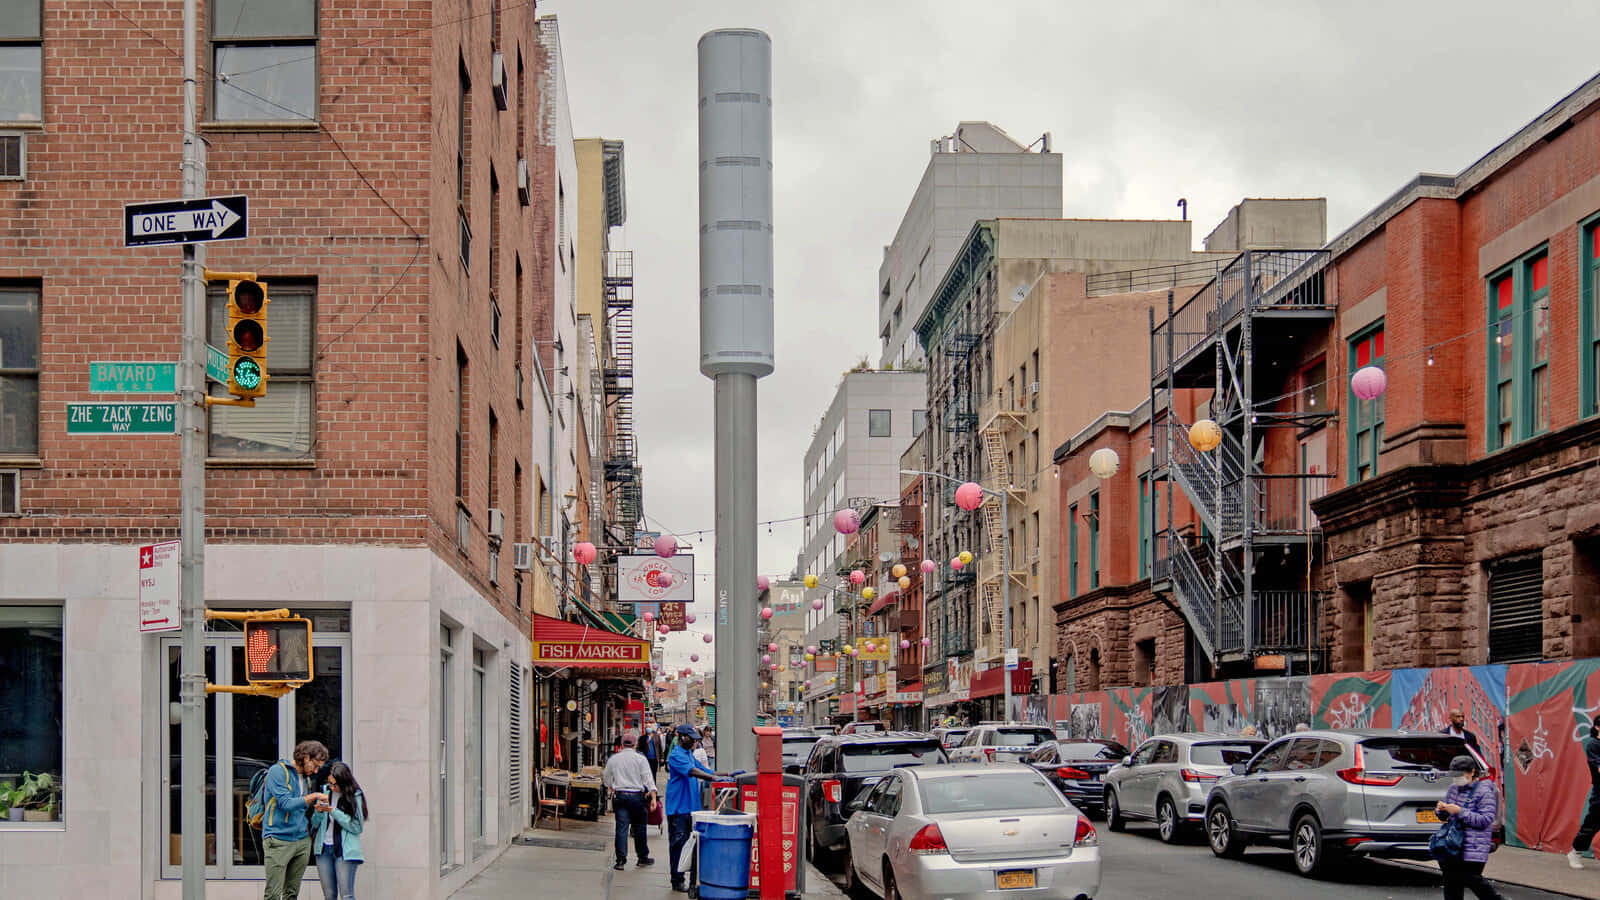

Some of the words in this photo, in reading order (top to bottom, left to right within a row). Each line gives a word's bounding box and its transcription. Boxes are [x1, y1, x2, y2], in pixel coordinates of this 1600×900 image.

[142, 214, 177, 233] ONE
[192, 210, 229, 229] WAY
[97, 366, 156, 382] BAYARD
[71, 406, 94, 423] ZHE
[96, 406, 138, 423] "ZACK"
[142, 406, 173, 423] ZENG
[112, 422, 131, 433] WAY
[541, 645, 573, 659] FISH
[578, 645, 640, 659] MARKET
